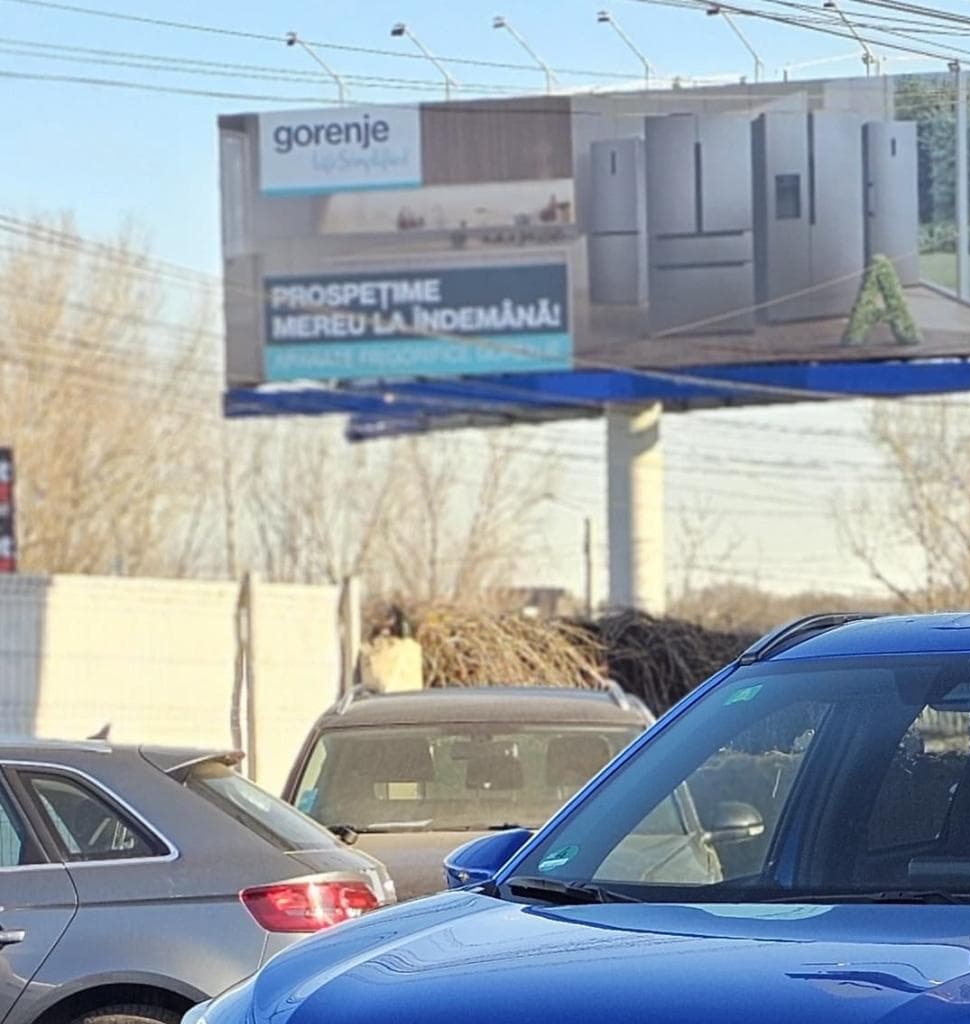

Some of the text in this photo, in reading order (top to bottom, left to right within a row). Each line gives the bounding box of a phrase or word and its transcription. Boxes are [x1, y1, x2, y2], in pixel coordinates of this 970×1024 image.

[273, 113, 391, 154] gorenje
[271, 311, 365, 340] MEREU
[373, 310, 412, 336] LA
